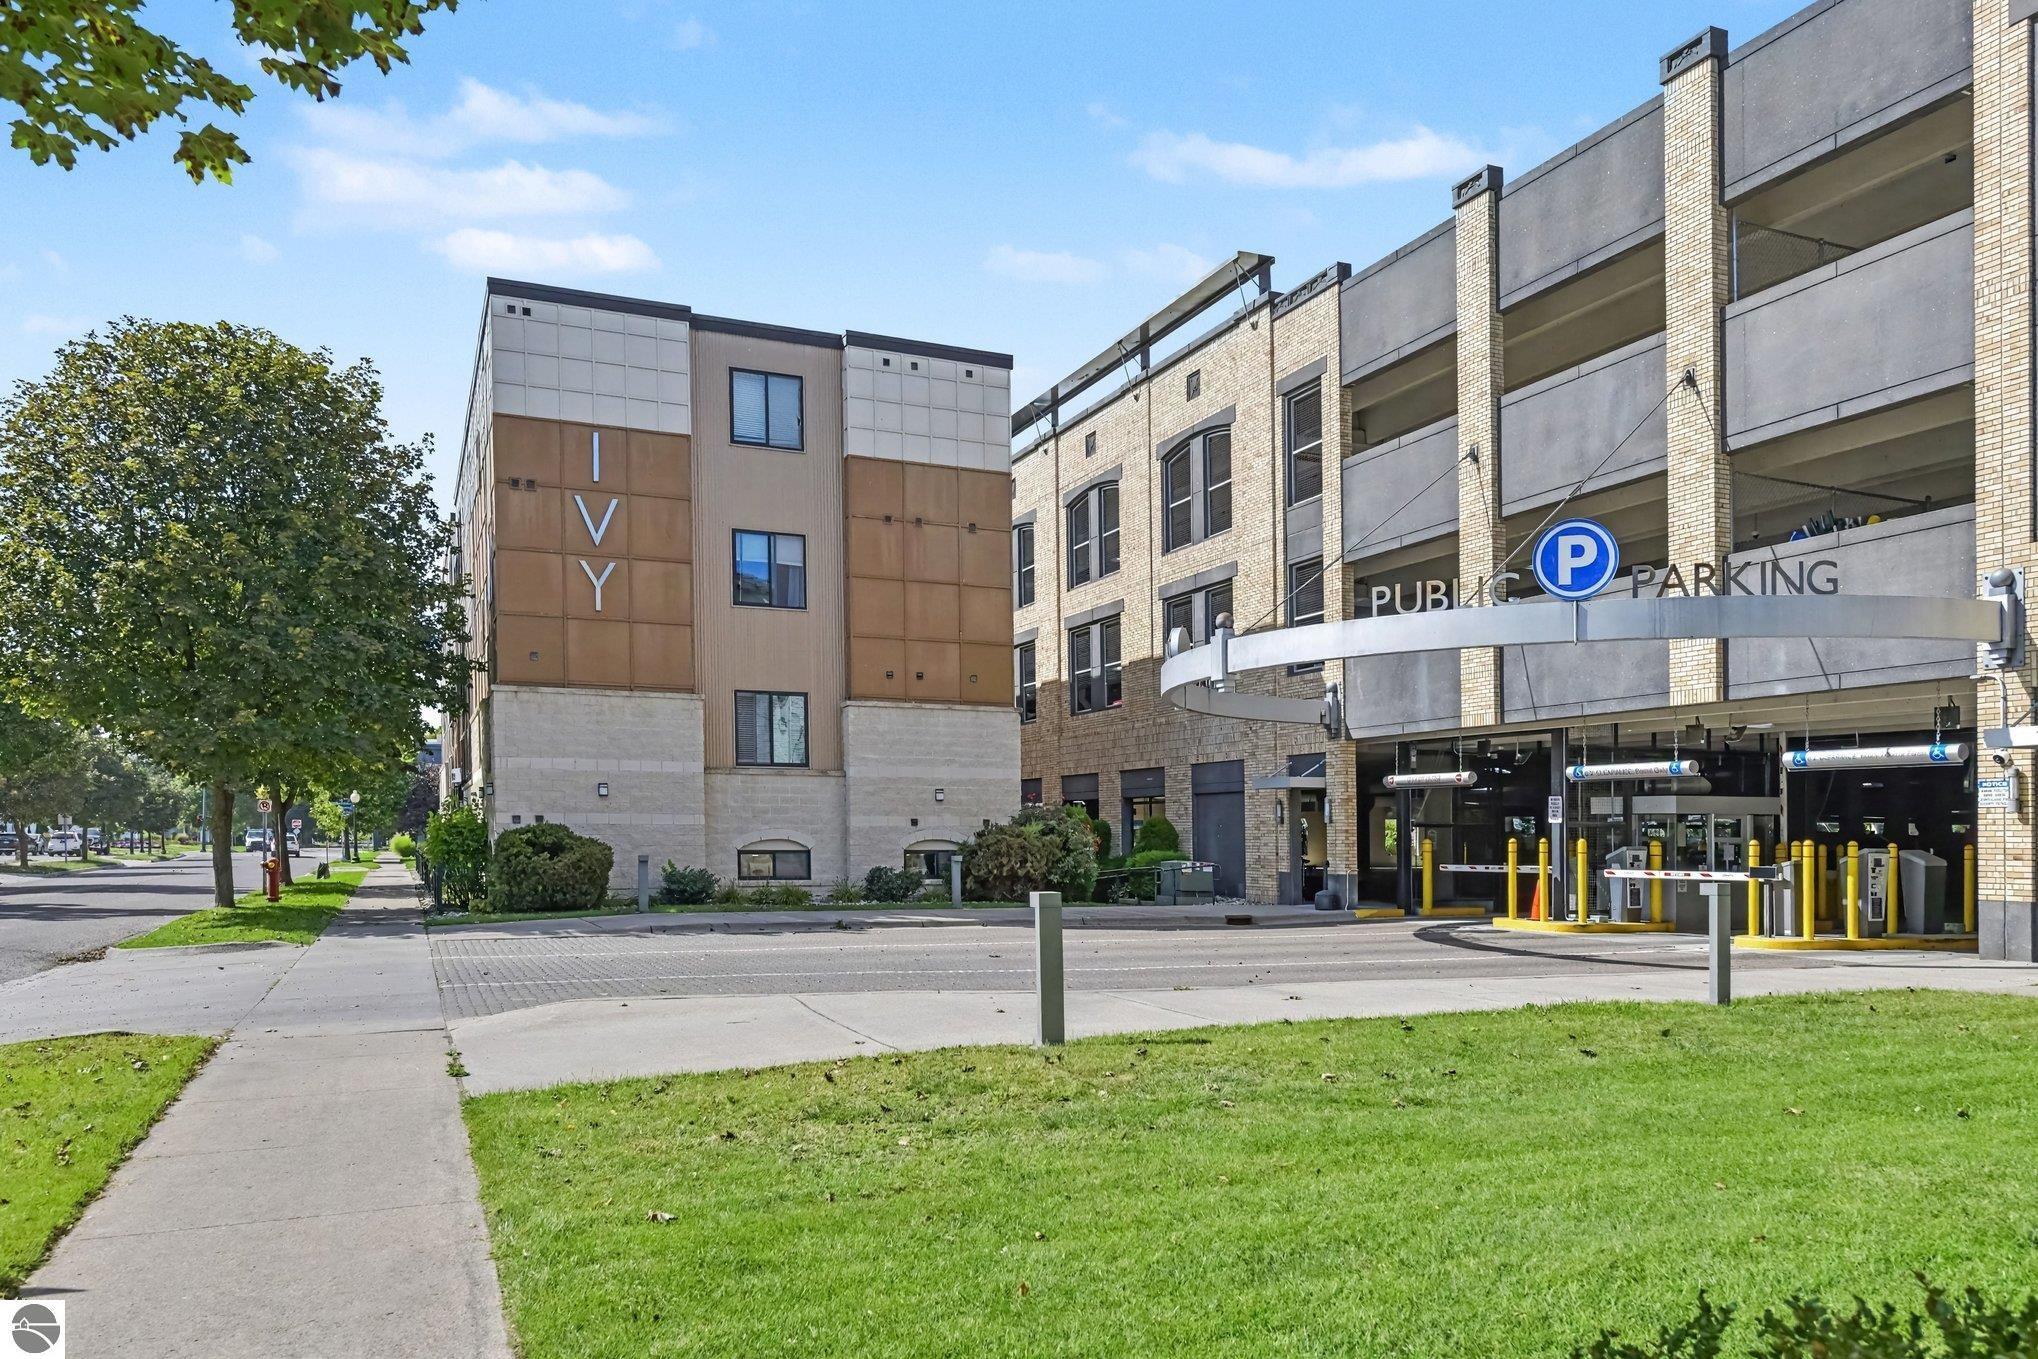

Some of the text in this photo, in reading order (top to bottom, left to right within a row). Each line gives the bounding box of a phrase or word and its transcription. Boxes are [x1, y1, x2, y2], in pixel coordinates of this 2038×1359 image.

[573, 431, 619, 612] IVY
[1371, 560, 1839, 617] PUBLIC PARKING
[1557, 534, 1598, 586] P
